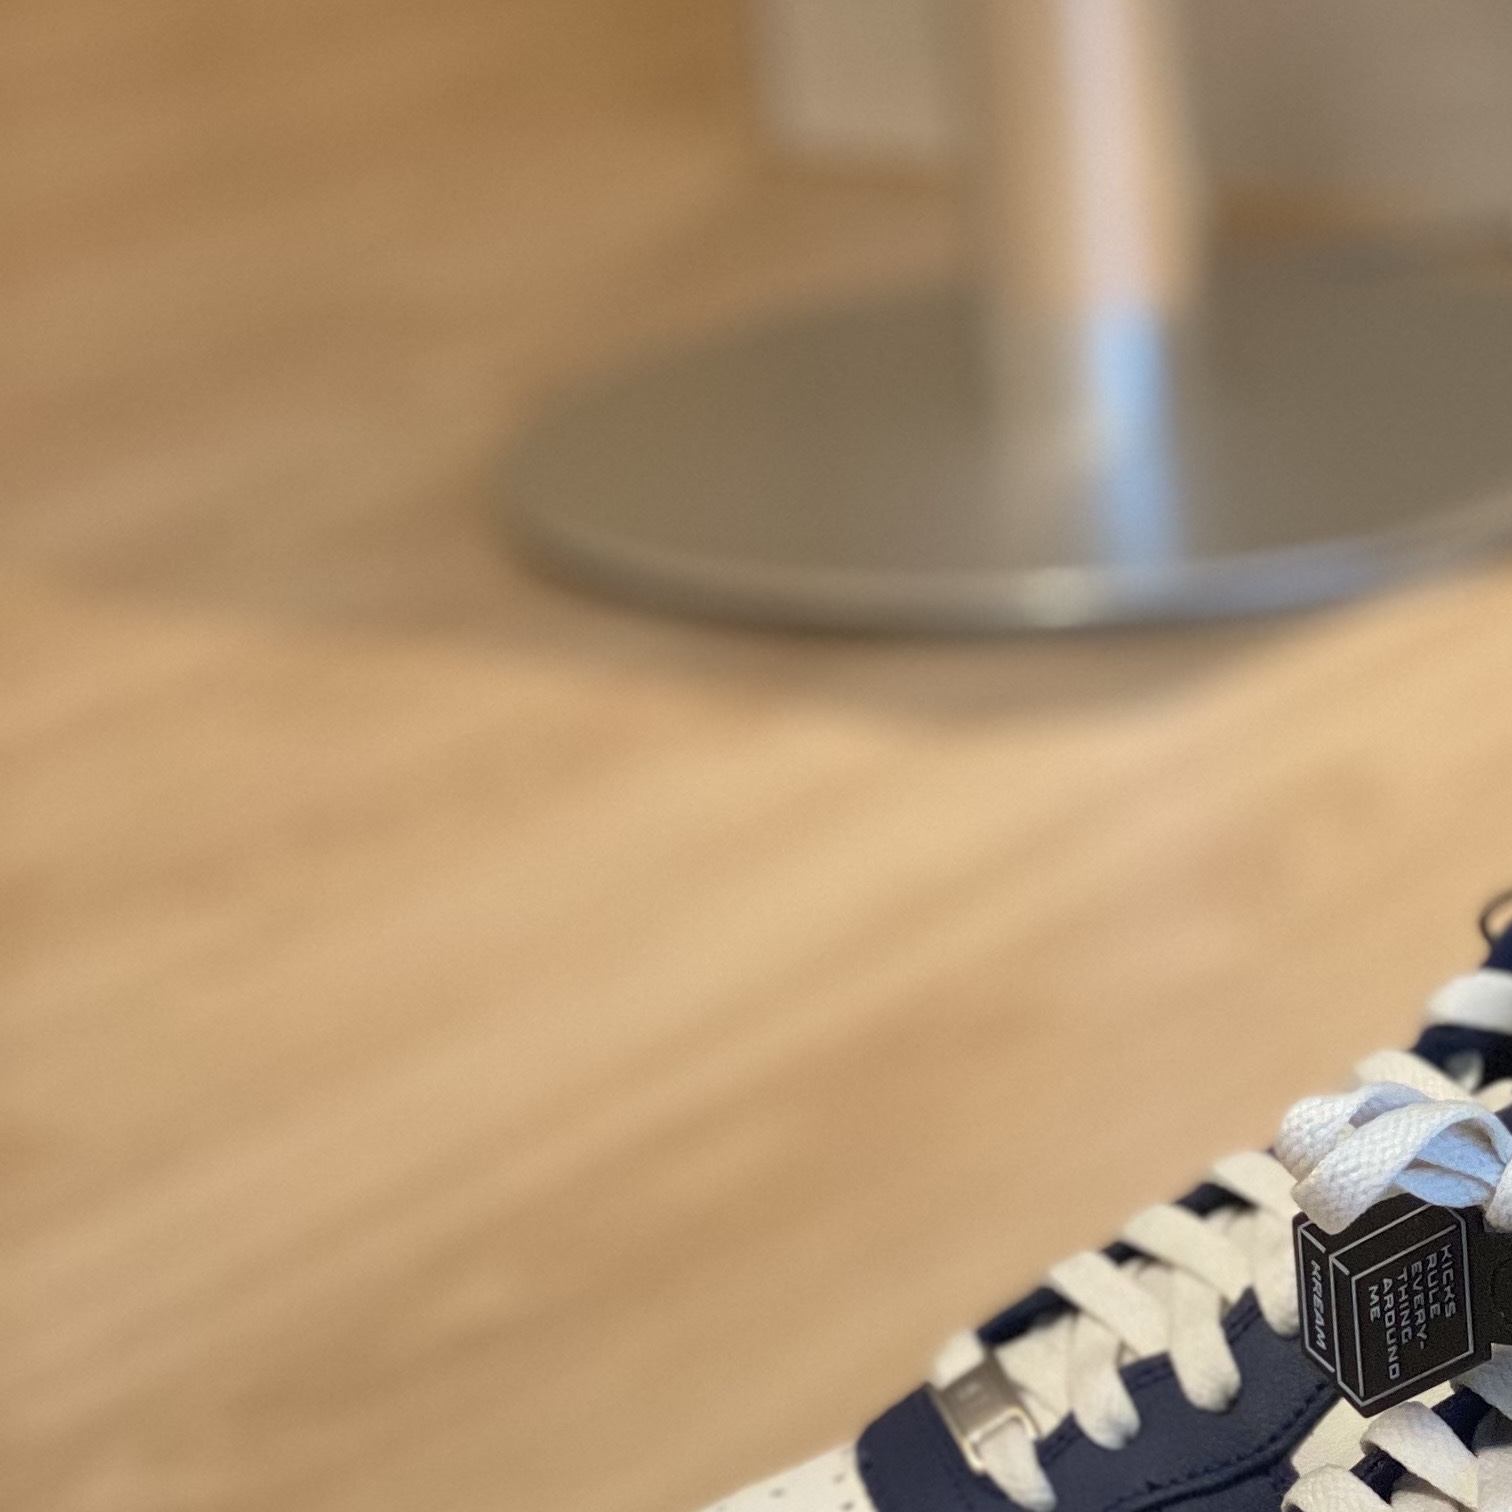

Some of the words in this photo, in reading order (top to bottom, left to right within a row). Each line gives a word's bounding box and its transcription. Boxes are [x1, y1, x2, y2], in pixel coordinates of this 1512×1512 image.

[1310, 1259, 1327, 1351] KREAM
[1368, 1285, 1381, 1322] ME
[1397, 1267, 1412, 1344] THING
[1412, 1261, 1428, 1350] EVERY-
[1426, 1252, 1441, 1319] RULE
[1440, 1244, 1456, 1318] KICKS
[1382, 1278, 1401, 1380] AROUND
